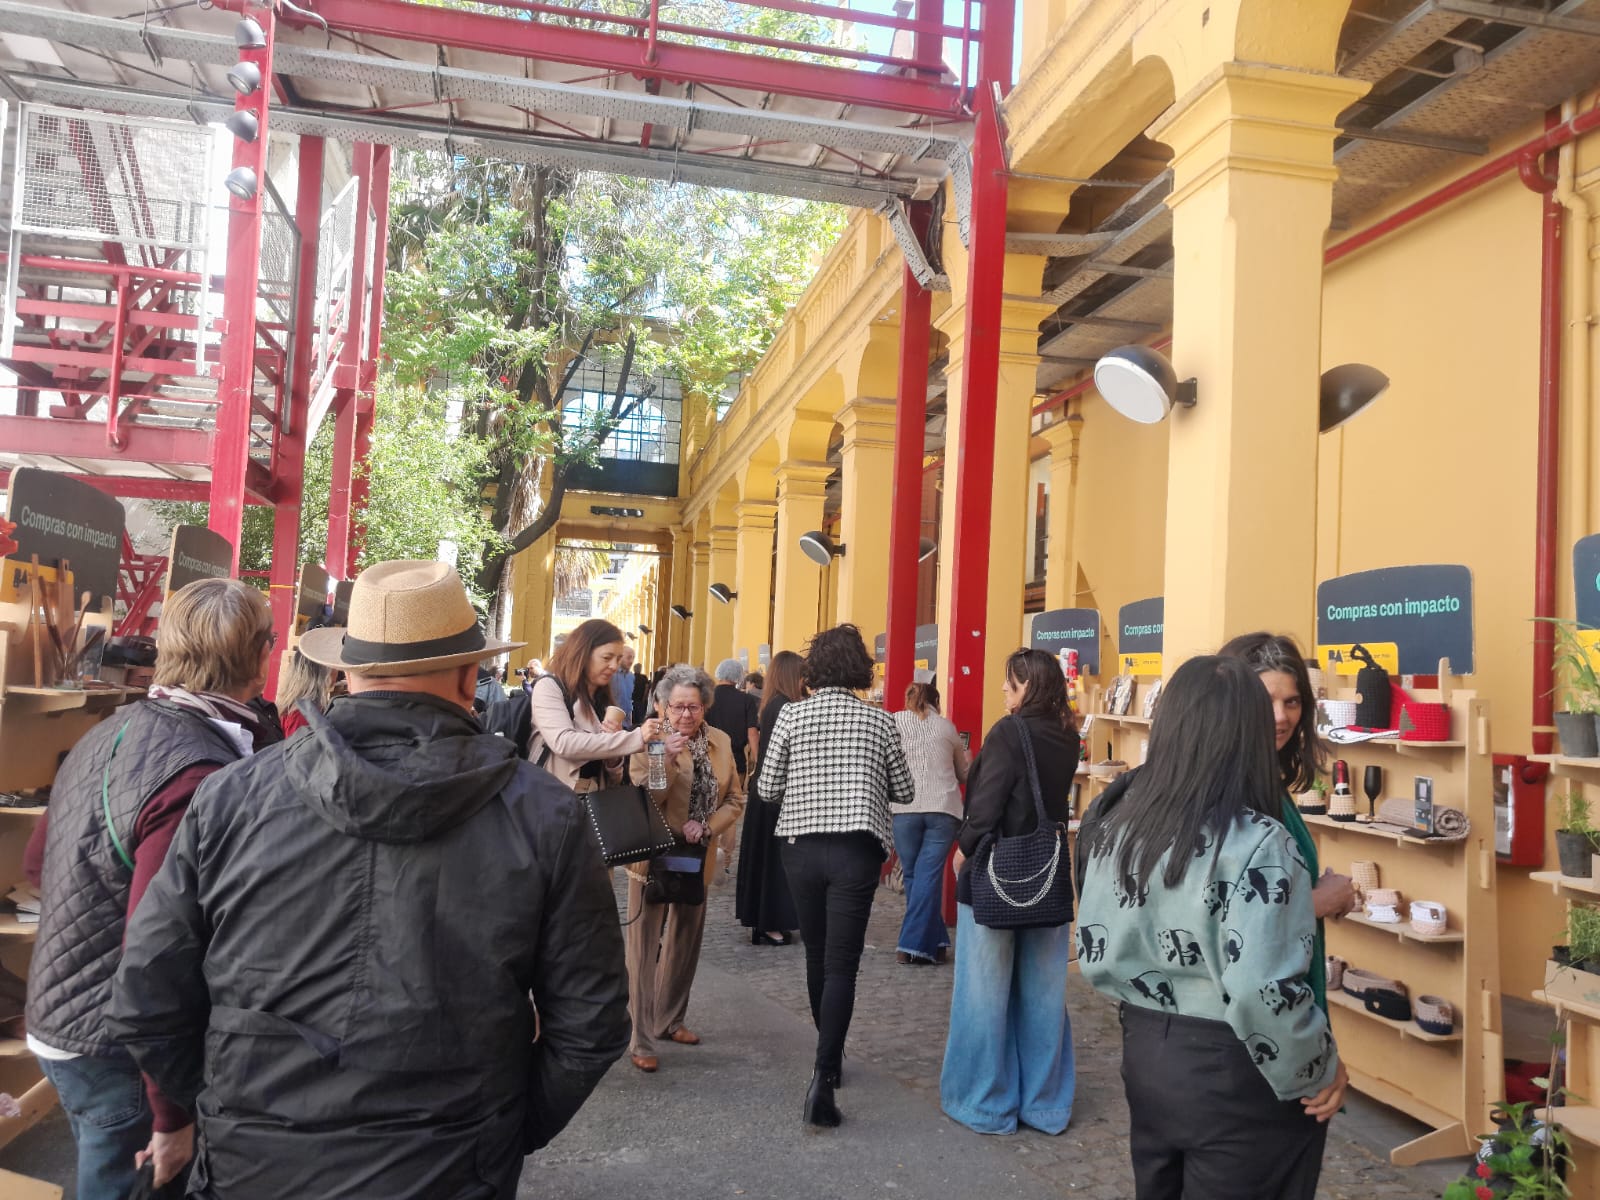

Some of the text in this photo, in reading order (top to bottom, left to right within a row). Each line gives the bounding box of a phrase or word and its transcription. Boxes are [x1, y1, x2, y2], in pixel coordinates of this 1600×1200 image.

[21, 505, 117, 549] Compras con impacto
[1327, 595, 1460, 622] Compras con impacto
[1036, 627, 1095, 641] Compras con impacto
[1124, 624, 1152, 637] Compras
